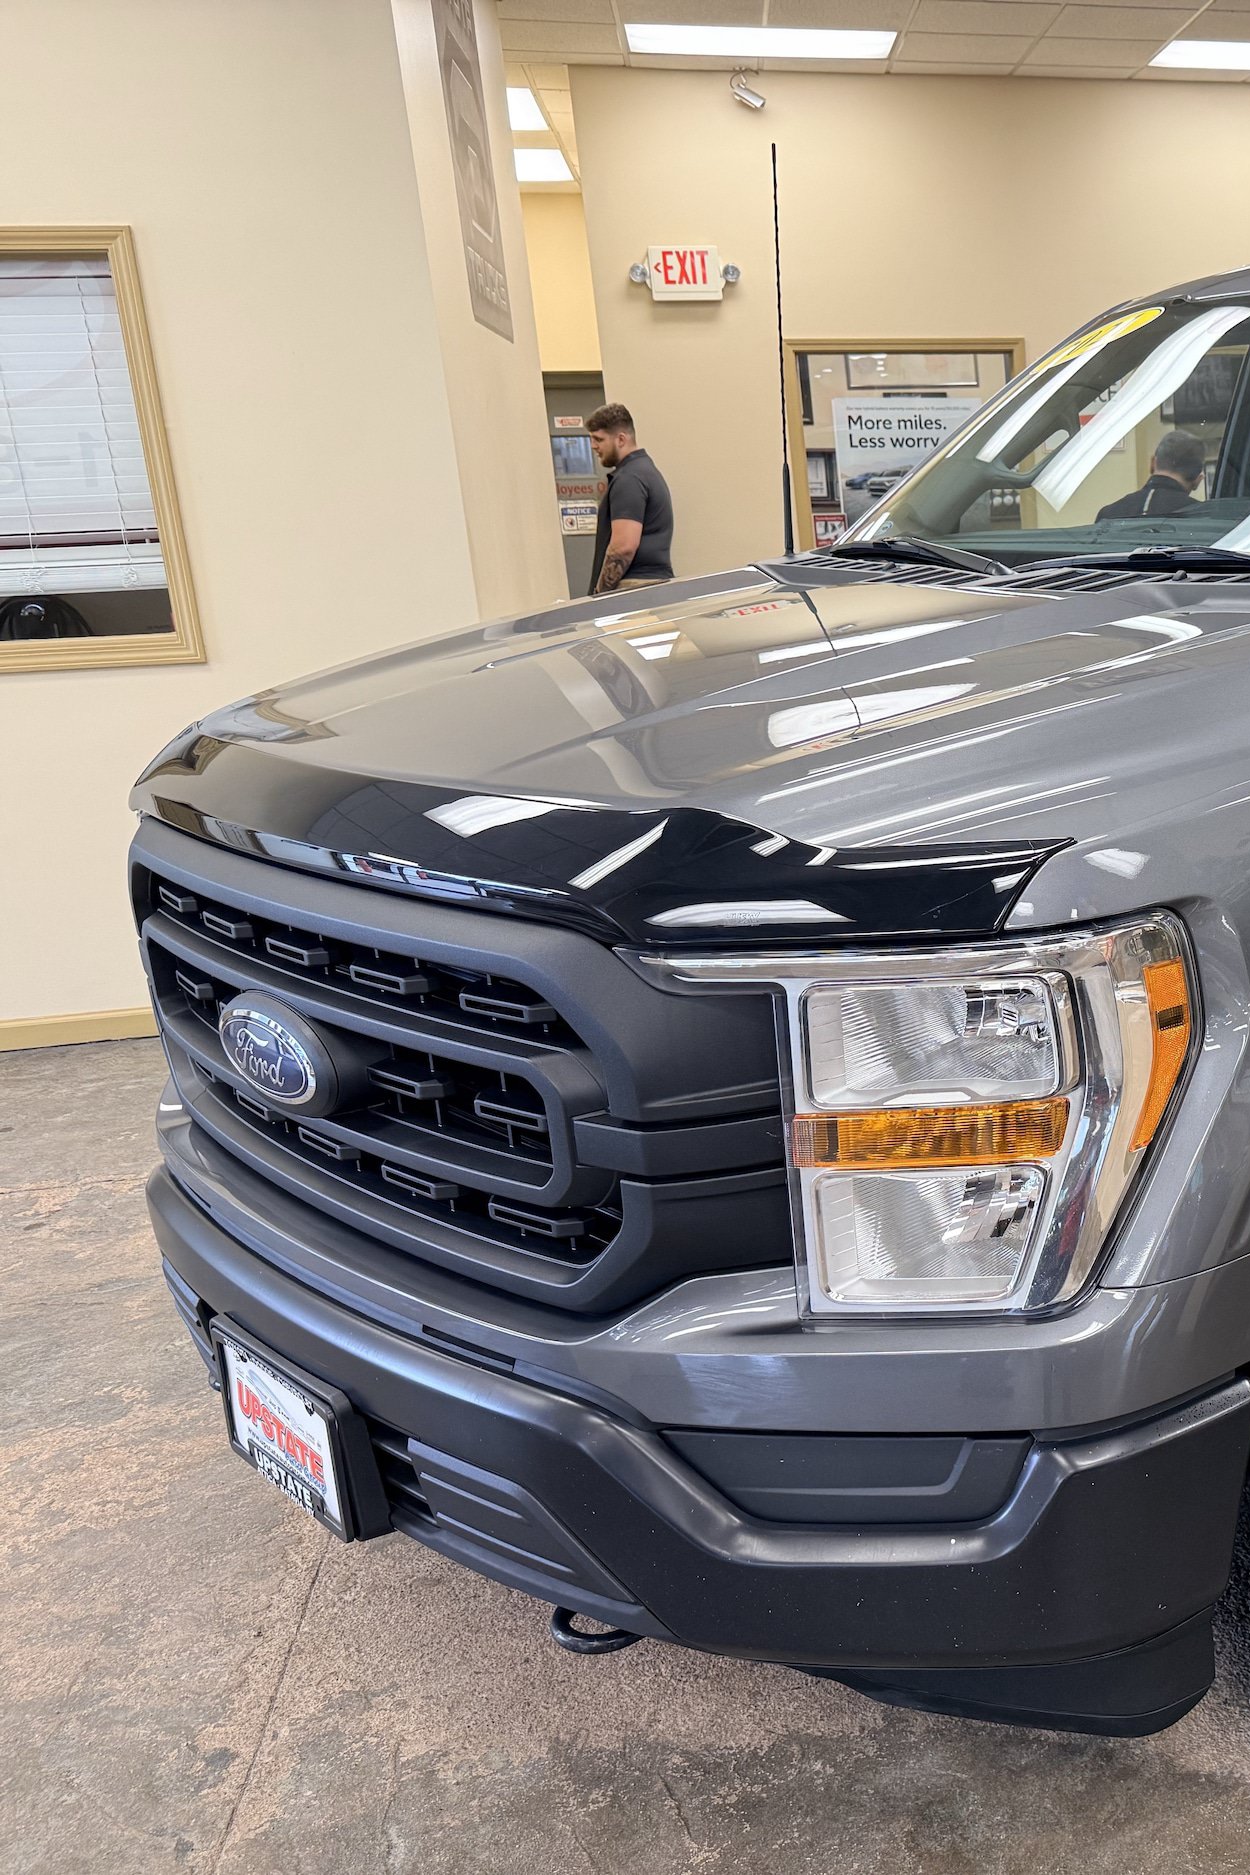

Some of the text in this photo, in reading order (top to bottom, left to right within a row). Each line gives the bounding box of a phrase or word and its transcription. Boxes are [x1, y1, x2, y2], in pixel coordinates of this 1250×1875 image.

[661, 249, 709, 285] EXIT
[848, 414, 947, 430] More miles.
[849, 434, 886, 448] Less
[567, 507, 592, 515] NOTICE
[235, 1027, 285, 1088] Ford
[236, 1377, 326, 1485] UPSTATE
[253, 1447, 313, 1509] UPSTATE
